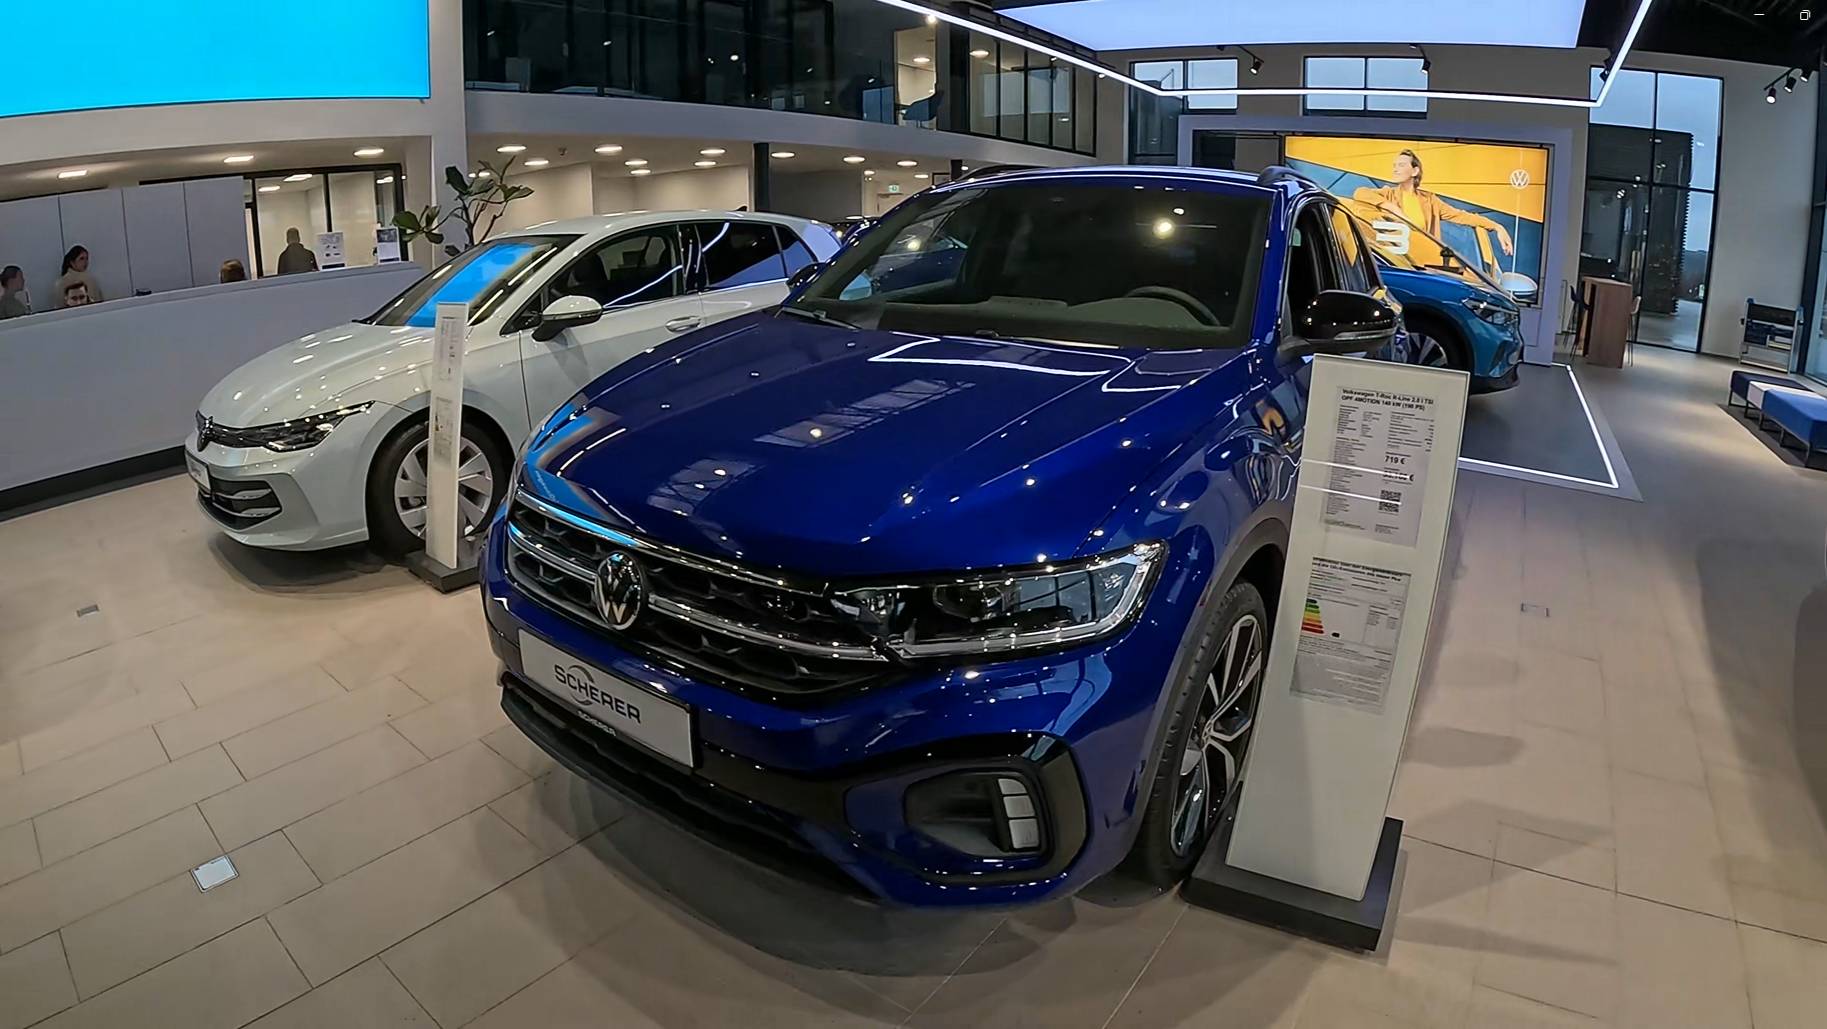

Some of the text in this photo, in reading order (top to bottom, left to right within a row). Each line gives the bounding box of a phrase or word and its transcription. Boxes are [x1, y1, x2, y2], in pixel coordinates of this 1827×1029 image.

[1342, 388, 1375, 397] Volkswagen
[1385, 455, 1399, 464] 719
[554, 664, 641, 724] SCHERER
